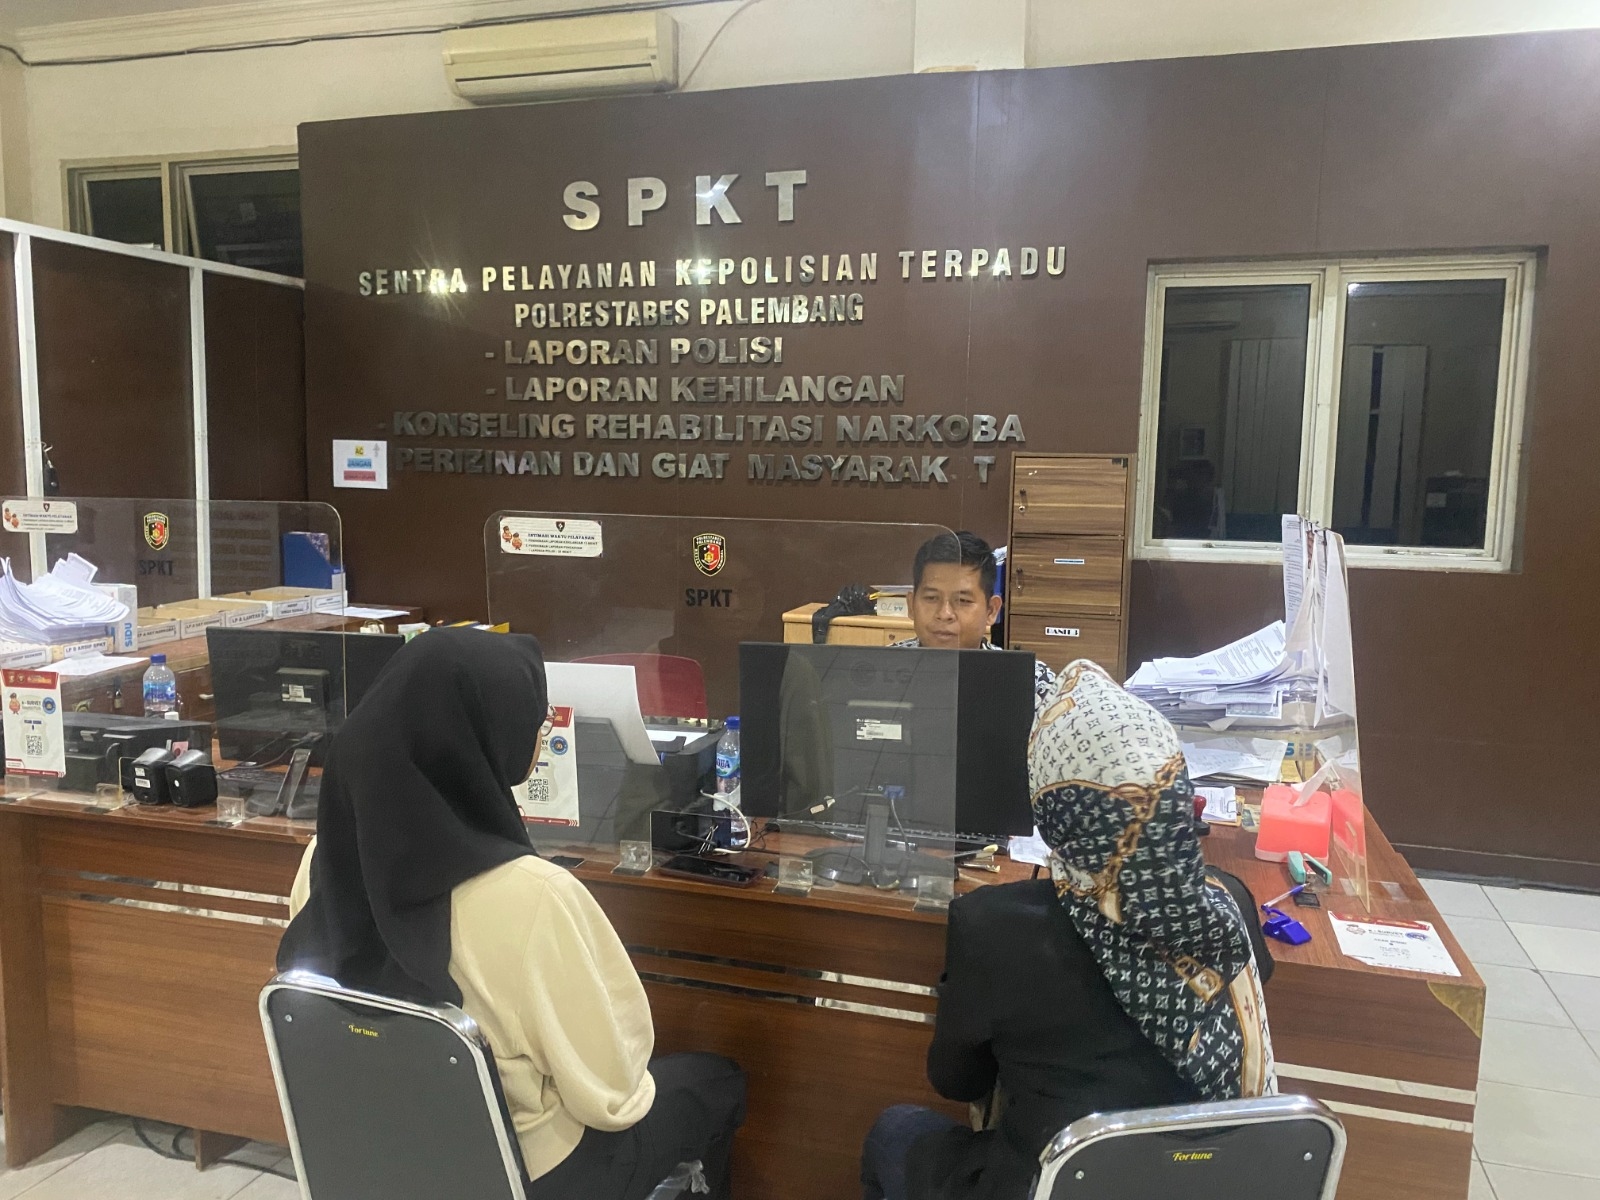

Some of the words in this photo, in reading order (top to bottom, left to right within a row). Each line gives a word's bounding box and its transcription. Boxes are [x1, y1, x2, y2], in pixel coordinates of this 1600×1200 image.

[359, 267, 467, 296] SENTRA
[482, 260, 655, 291] PELAYANAN
[676, 252, 877, 286] KEPOLISIAN
[899, 246, 1065, 278] TERPADU
[515, 299, 688, 328] POLRESTABES
[700, 293, 863, 325] PALEMBANG
[505, 338, 658, 365] LAPORAN
[670, 336, 783, 364] POLISI
[506, 376, 658, 402] LAPORAN
[671, 374, 905, 402] KEHILANGAN
[393, 411, 575, 439] KONSELING
[586, 413, 824, 442] REHABILITASI
[836, 413, 1025, 442] NARKOBA
[394, 447, 561, 476] PERIZINAN
[573, 451, 640, 477] DAN
[651, 452, 730, 479] GIAT
[139, 560, 173, 576] SPKT
[686, 588, 732, 607] SPKT
[348, 1024, 380, 1038] Fortune
[1172, 1152, 1213, 1162] Fortune
